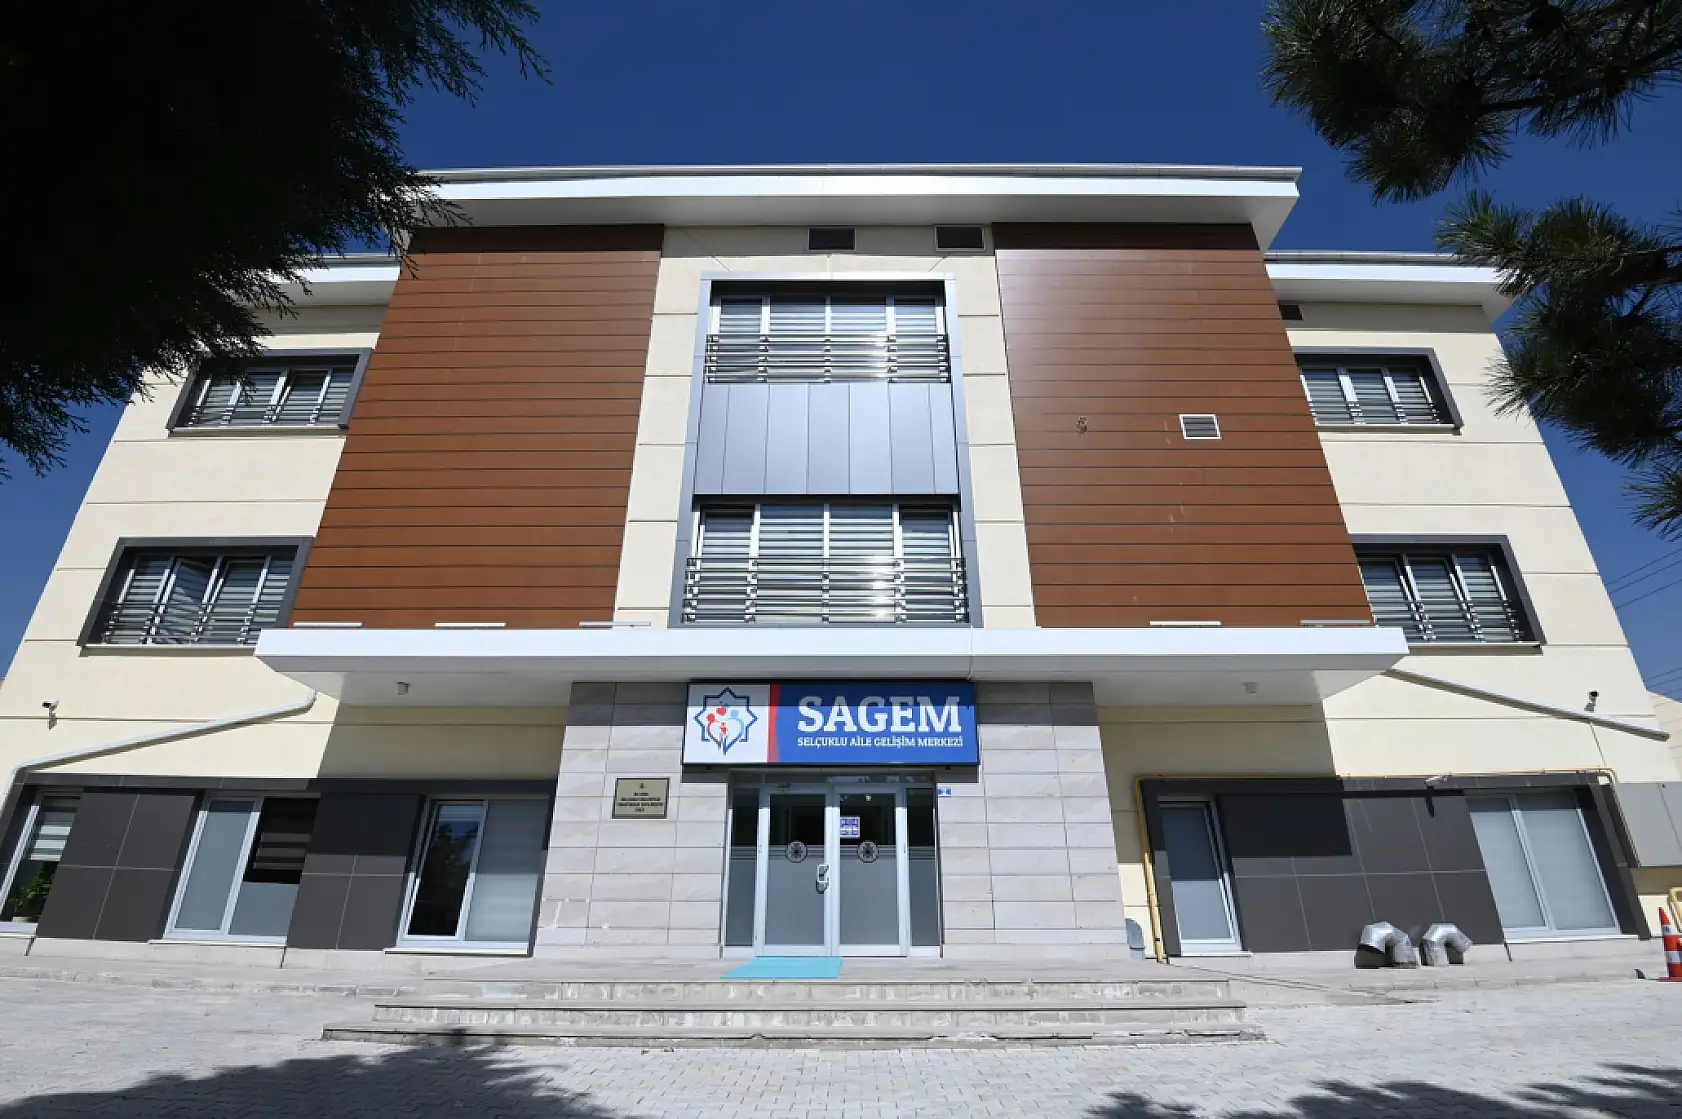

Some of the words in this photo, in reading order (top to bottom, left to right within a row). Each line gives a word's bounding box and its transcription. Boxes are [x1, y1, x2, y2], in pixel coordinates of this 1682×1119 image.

[797, 696, 962, 733] SAGEM
[797, 736, 848, 749] SELÇUKLU
[850, 735, 872, 747] AİLE
[874, 735, 916, 749] GELİŞİM
[918, 735, 963, 747] MERKEZİ
